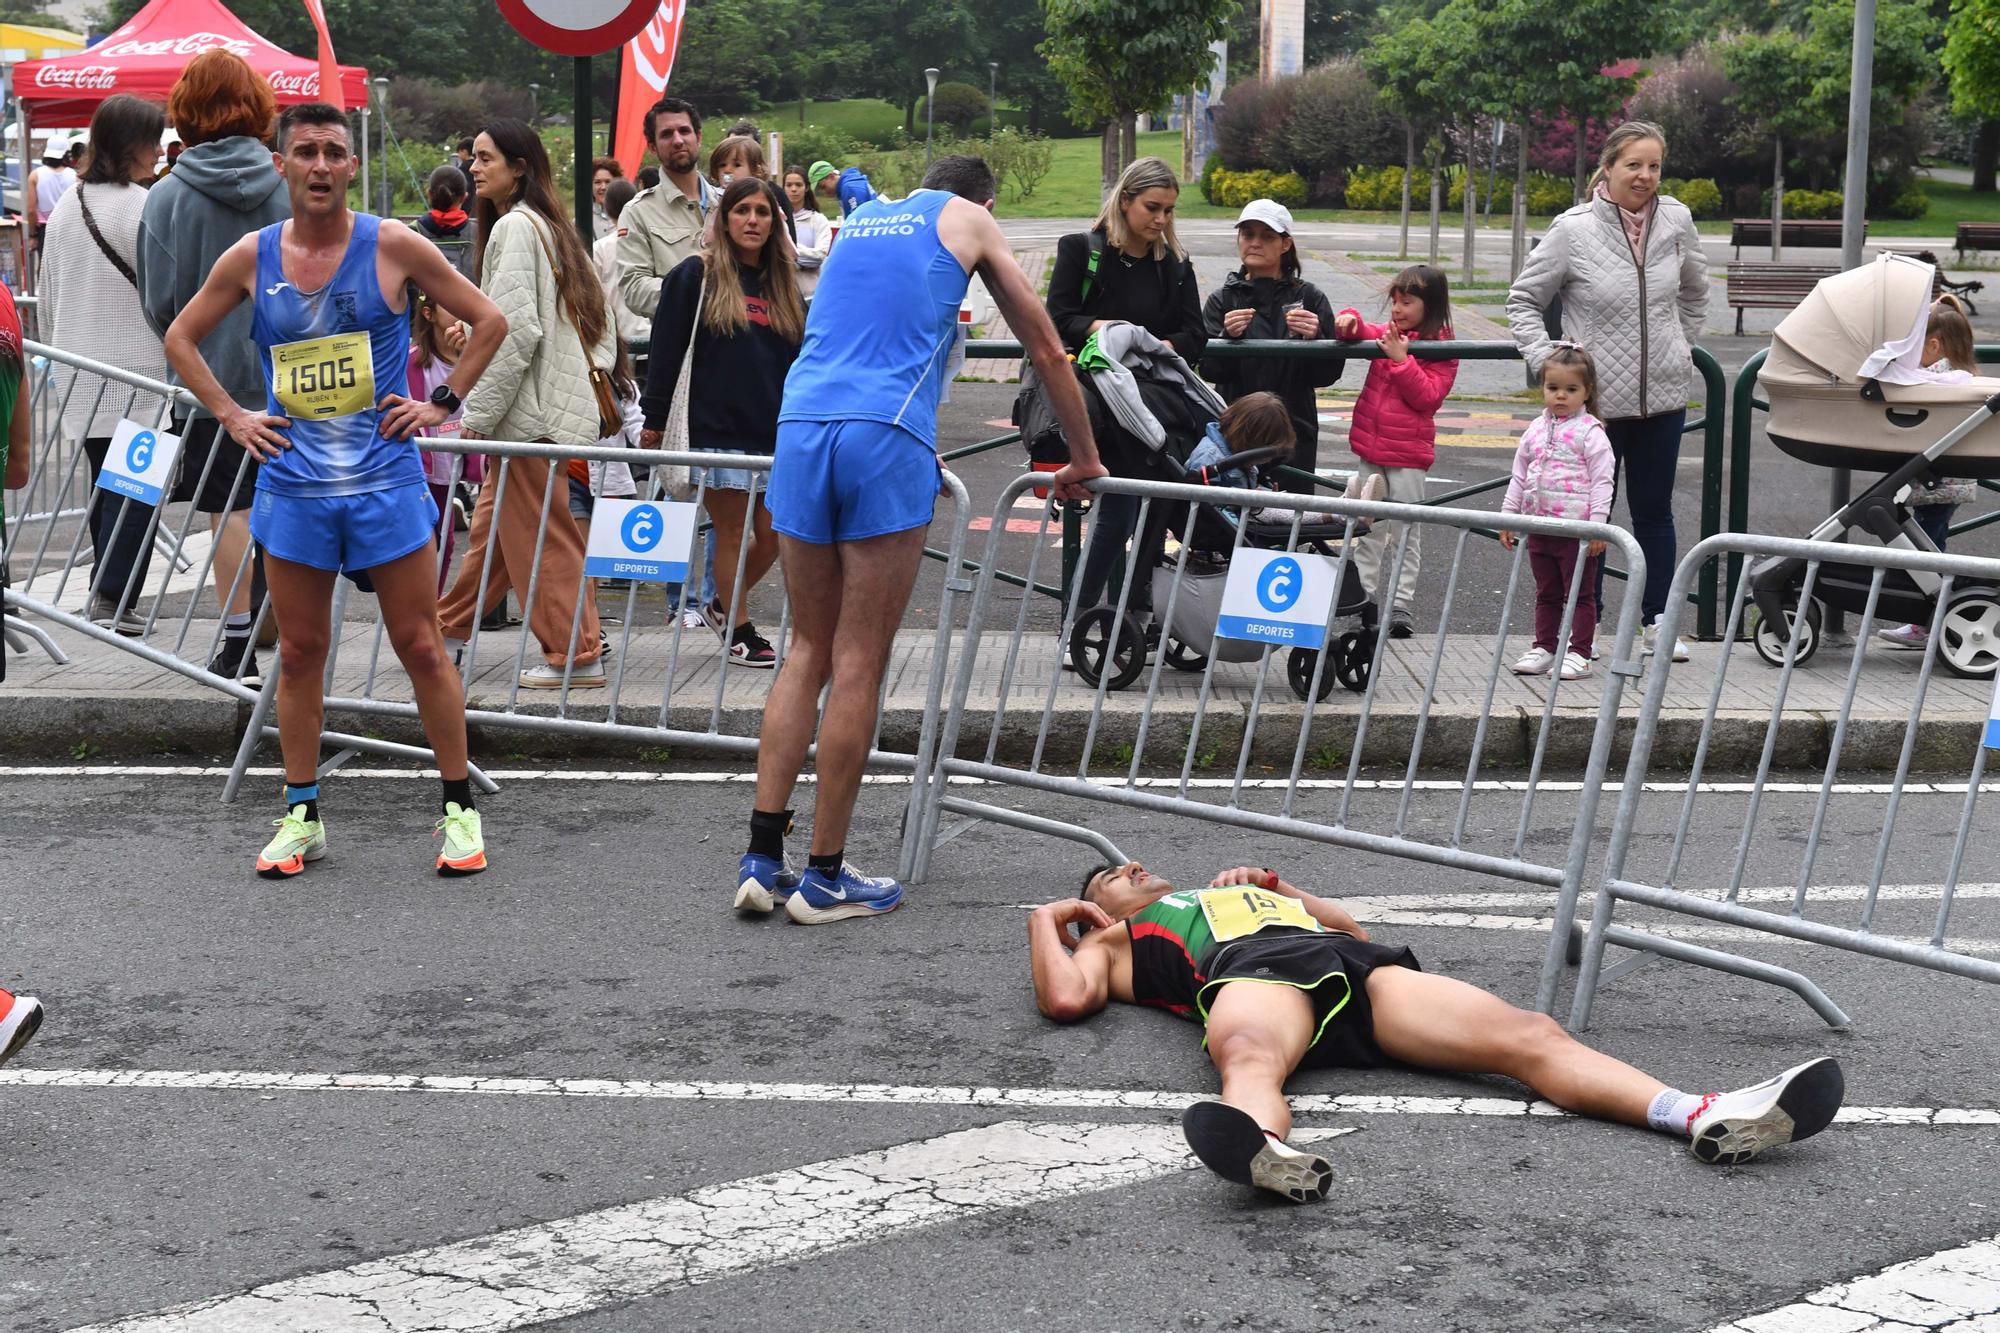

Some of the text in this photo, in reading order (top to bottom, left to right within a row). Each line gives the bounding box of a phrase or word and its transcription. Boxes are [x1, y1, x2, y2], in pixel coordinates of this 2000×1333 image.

[846, 213, 926, 226] ARINEDA
[290, 356, 355, 394] 1505
[114, 478, 145, 495] DEPORTES
[614, 563, 659, 575] DEPORTES
[1246, 623, 1295, 638] DEPORTES
